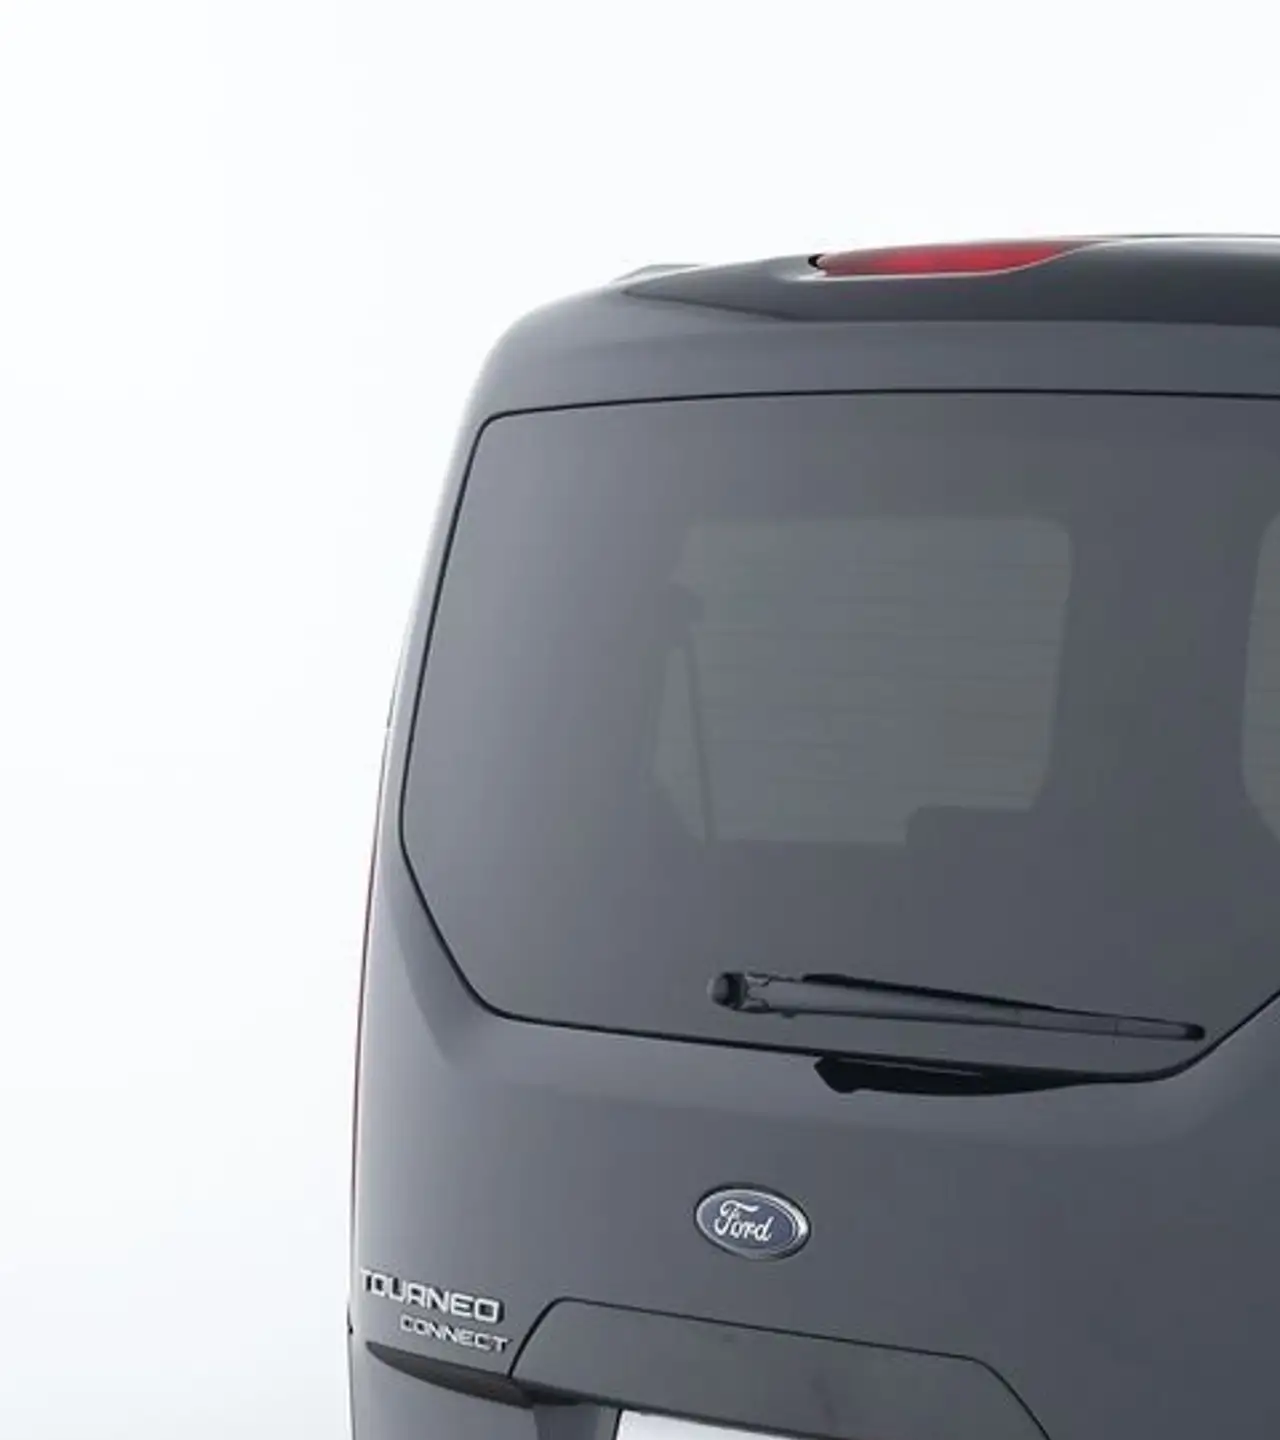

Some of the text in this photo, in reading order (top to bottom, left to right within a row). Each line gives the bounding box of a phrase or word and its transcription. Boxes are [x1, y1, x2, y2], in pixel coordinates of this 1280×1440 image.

[714, 1199, 775, 1241] Ford
[360, 1267, 504, 1324] TOURNEO
[400, 1314, 510, 1352] CONNECT
